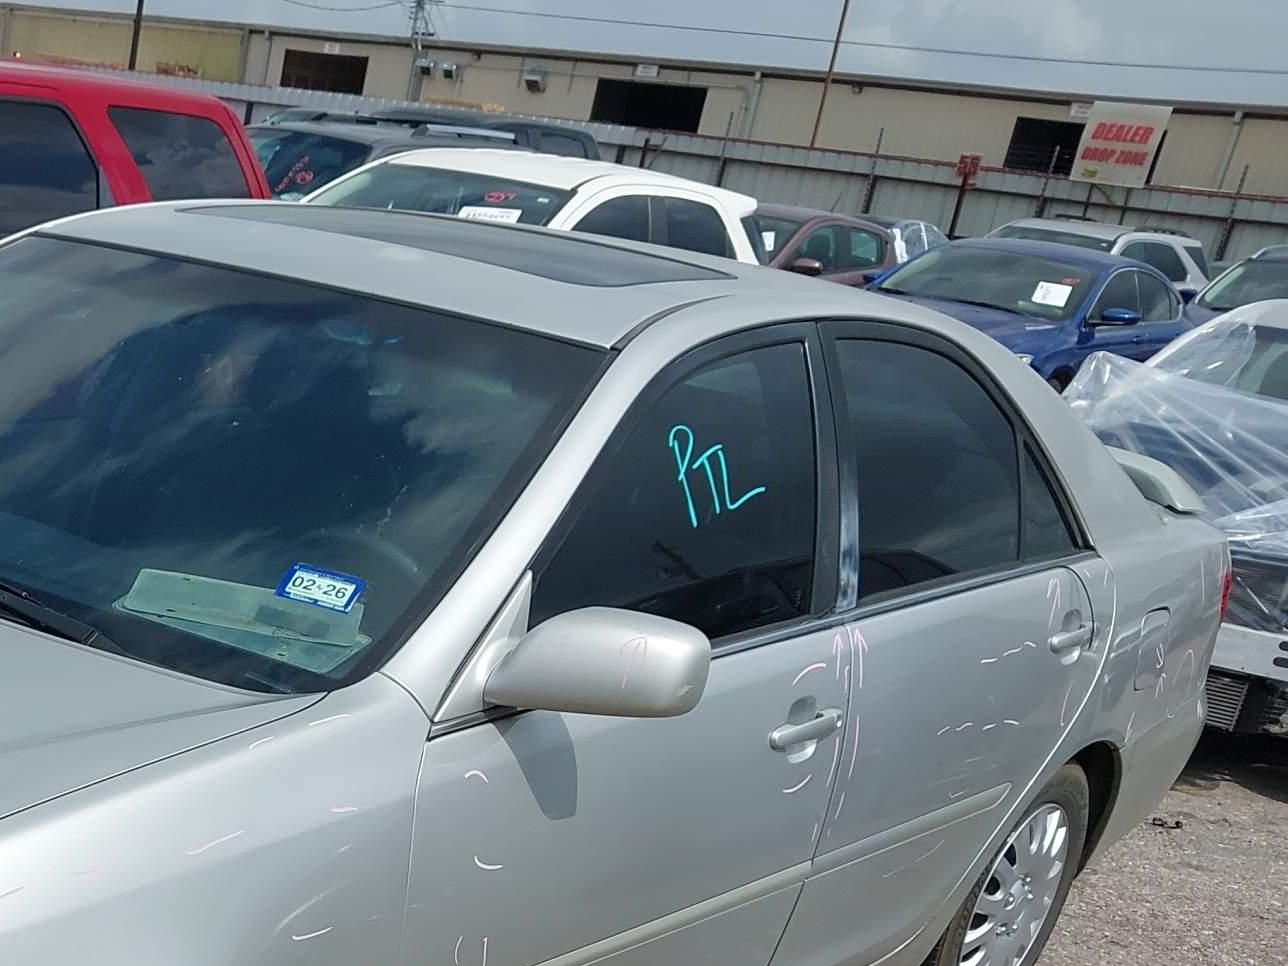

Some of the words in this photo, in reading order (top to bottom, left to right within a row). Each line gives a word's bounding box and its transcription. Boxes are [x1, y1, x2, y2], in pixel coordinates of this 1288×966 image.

[1091, 122, 1155, 144] DEALER
[1080, 146, 1117, 163] DROP
[1114, 150, 1149, 166] ZONE
[668, 425, 767, 528] PTL
[291, 576, 317, 591] 02
[322, 584, 349, 599] 26
